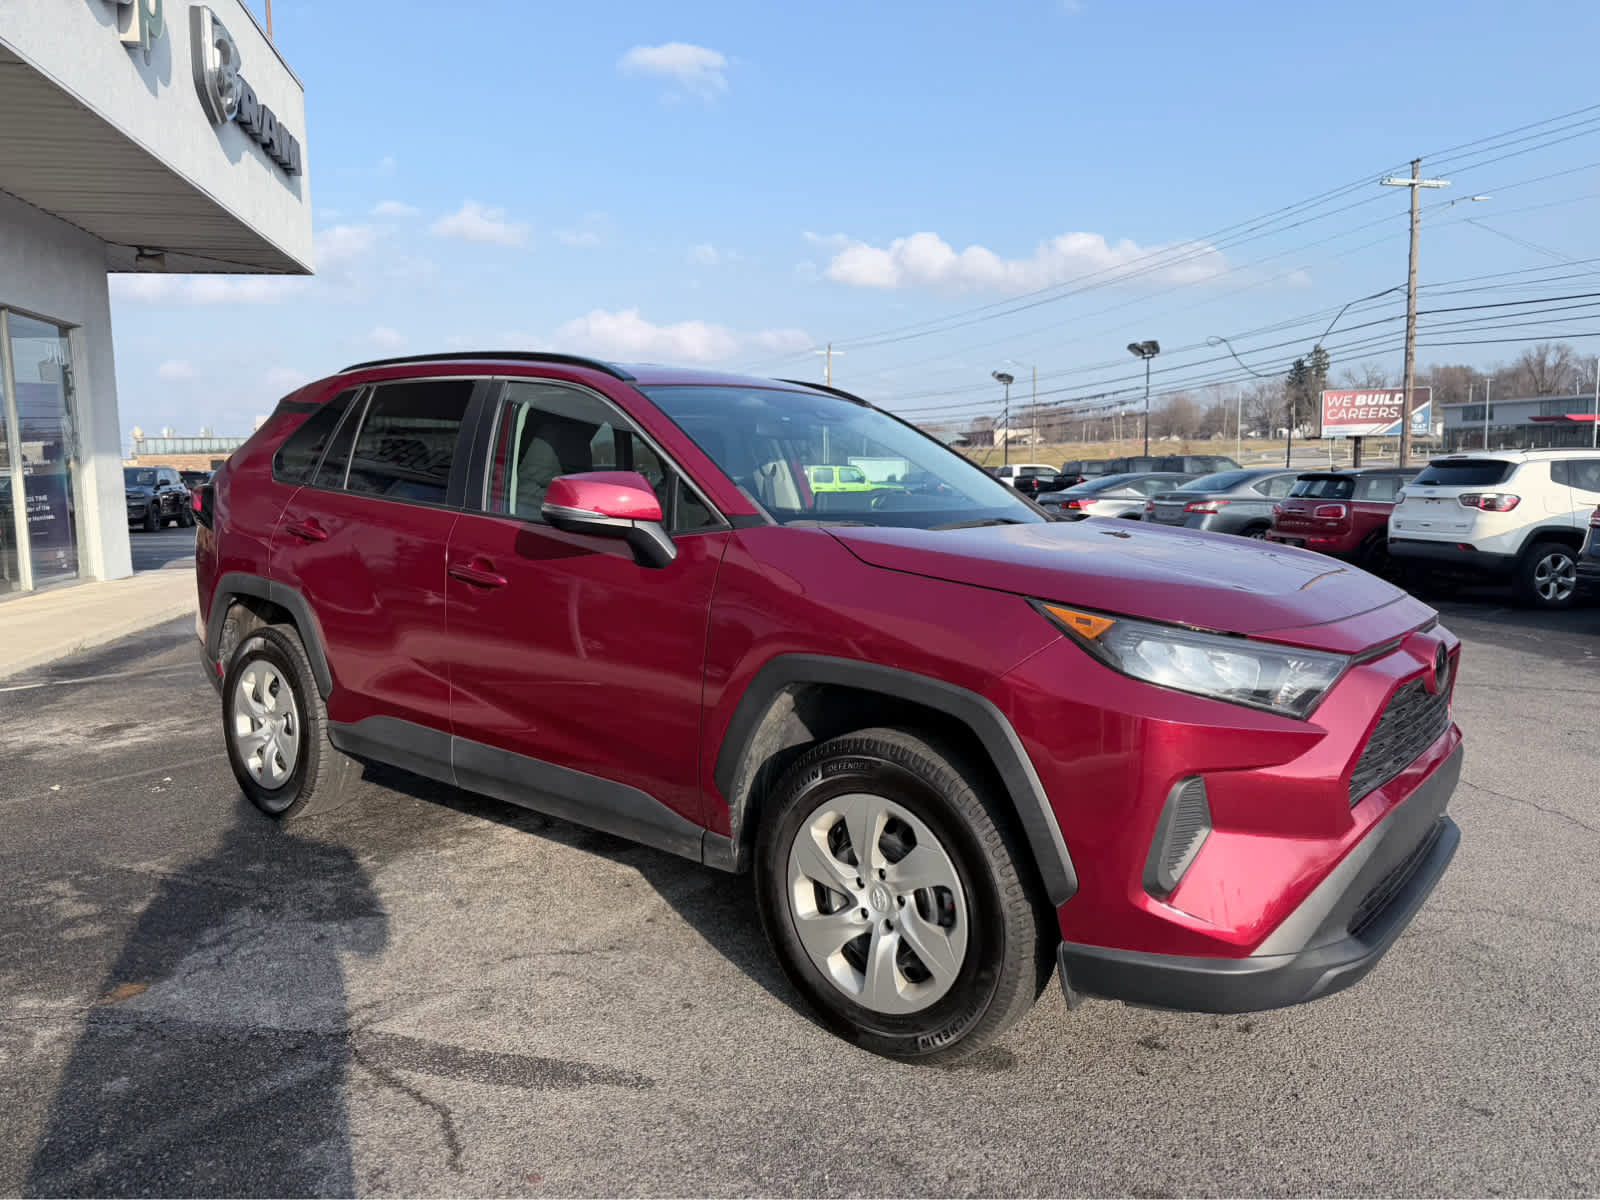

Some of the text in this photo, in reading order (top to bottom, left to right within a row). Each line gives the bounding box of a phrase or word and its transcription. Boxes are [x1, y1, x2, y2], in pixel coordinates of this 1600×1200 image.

[237, 74, 302, 176] RAM
[1327, 393, 1404, 407] WE BUILD
[1327, 407, 1401, 420] CAREERS.
